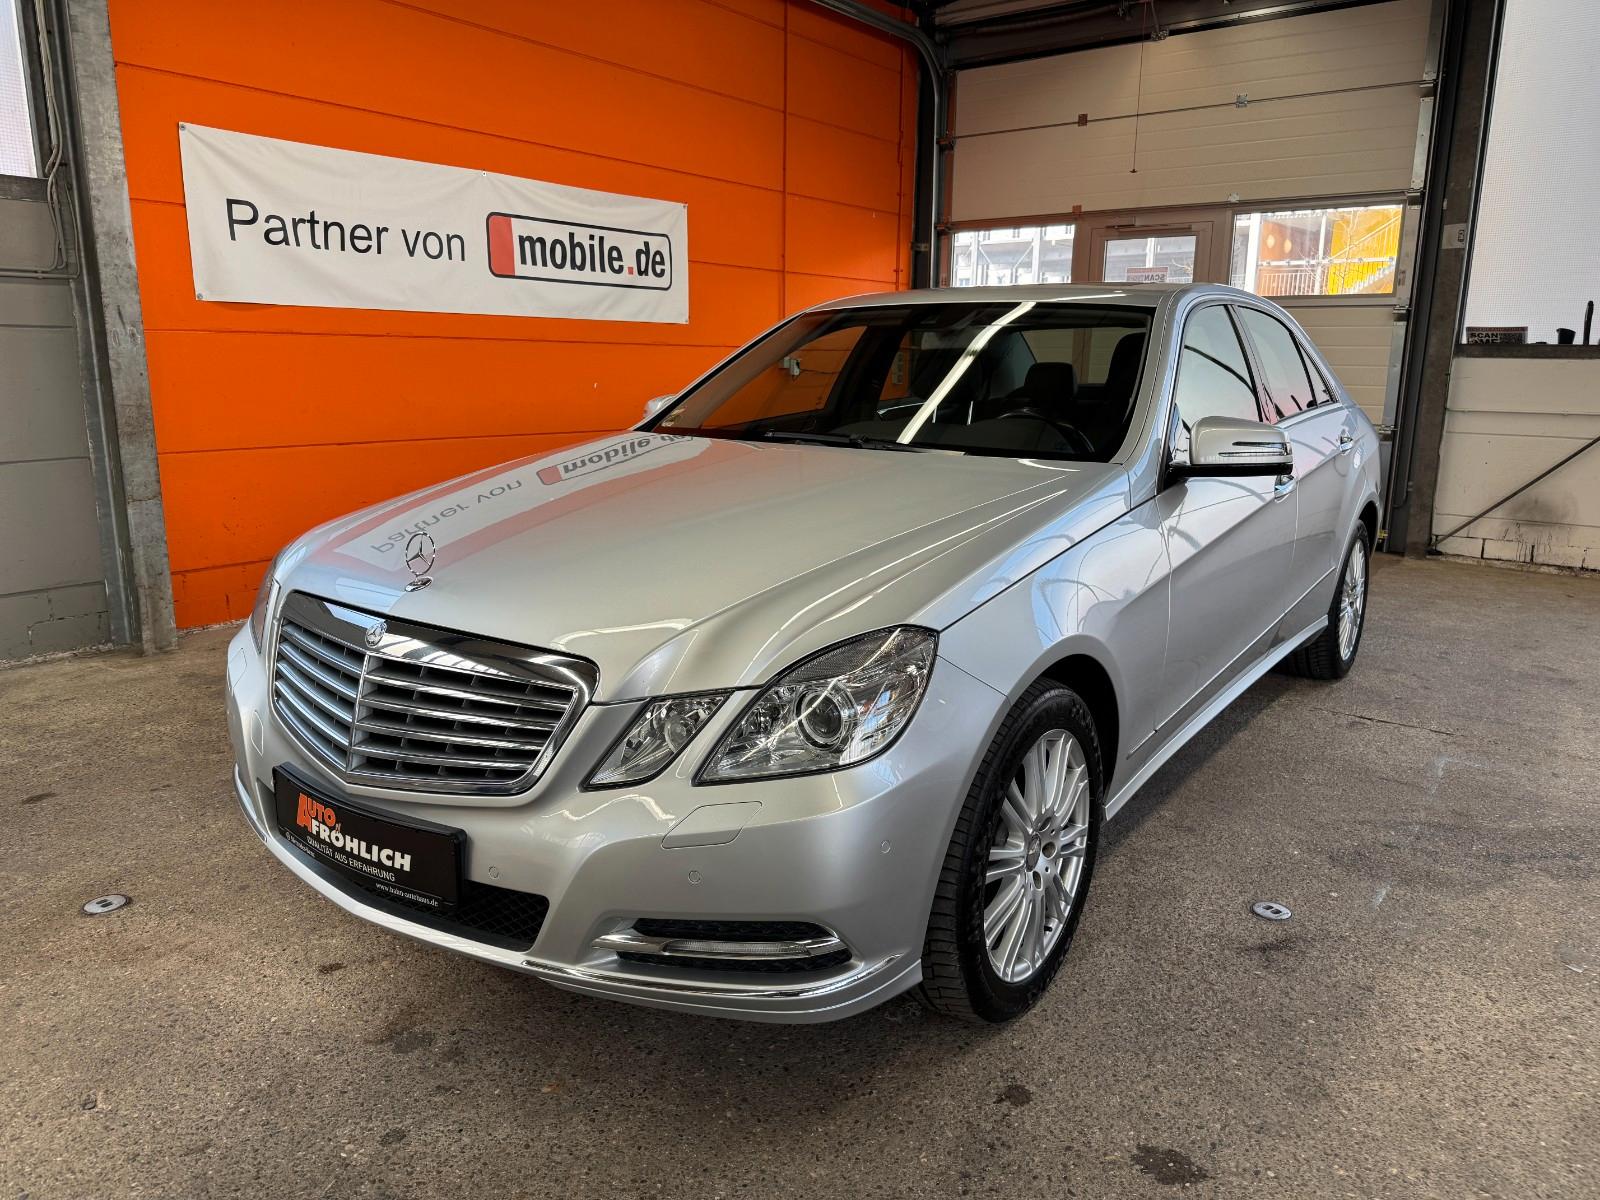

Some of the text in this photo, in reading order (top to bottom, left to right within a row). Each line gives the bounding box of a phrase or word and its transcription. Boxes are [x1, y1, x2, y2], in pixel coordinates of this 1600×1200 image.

[226, 198, 666, 278] Partner von mobile.de
[296, 793, 336, 833] AUTO
[306, 835, 333, 857] QUALITÄT
[334, 851, 348, 864] AUS
[349, 857, 395, 882] ERFAHRUNG
[311, 819, 411, 872] FRÖHLICH
